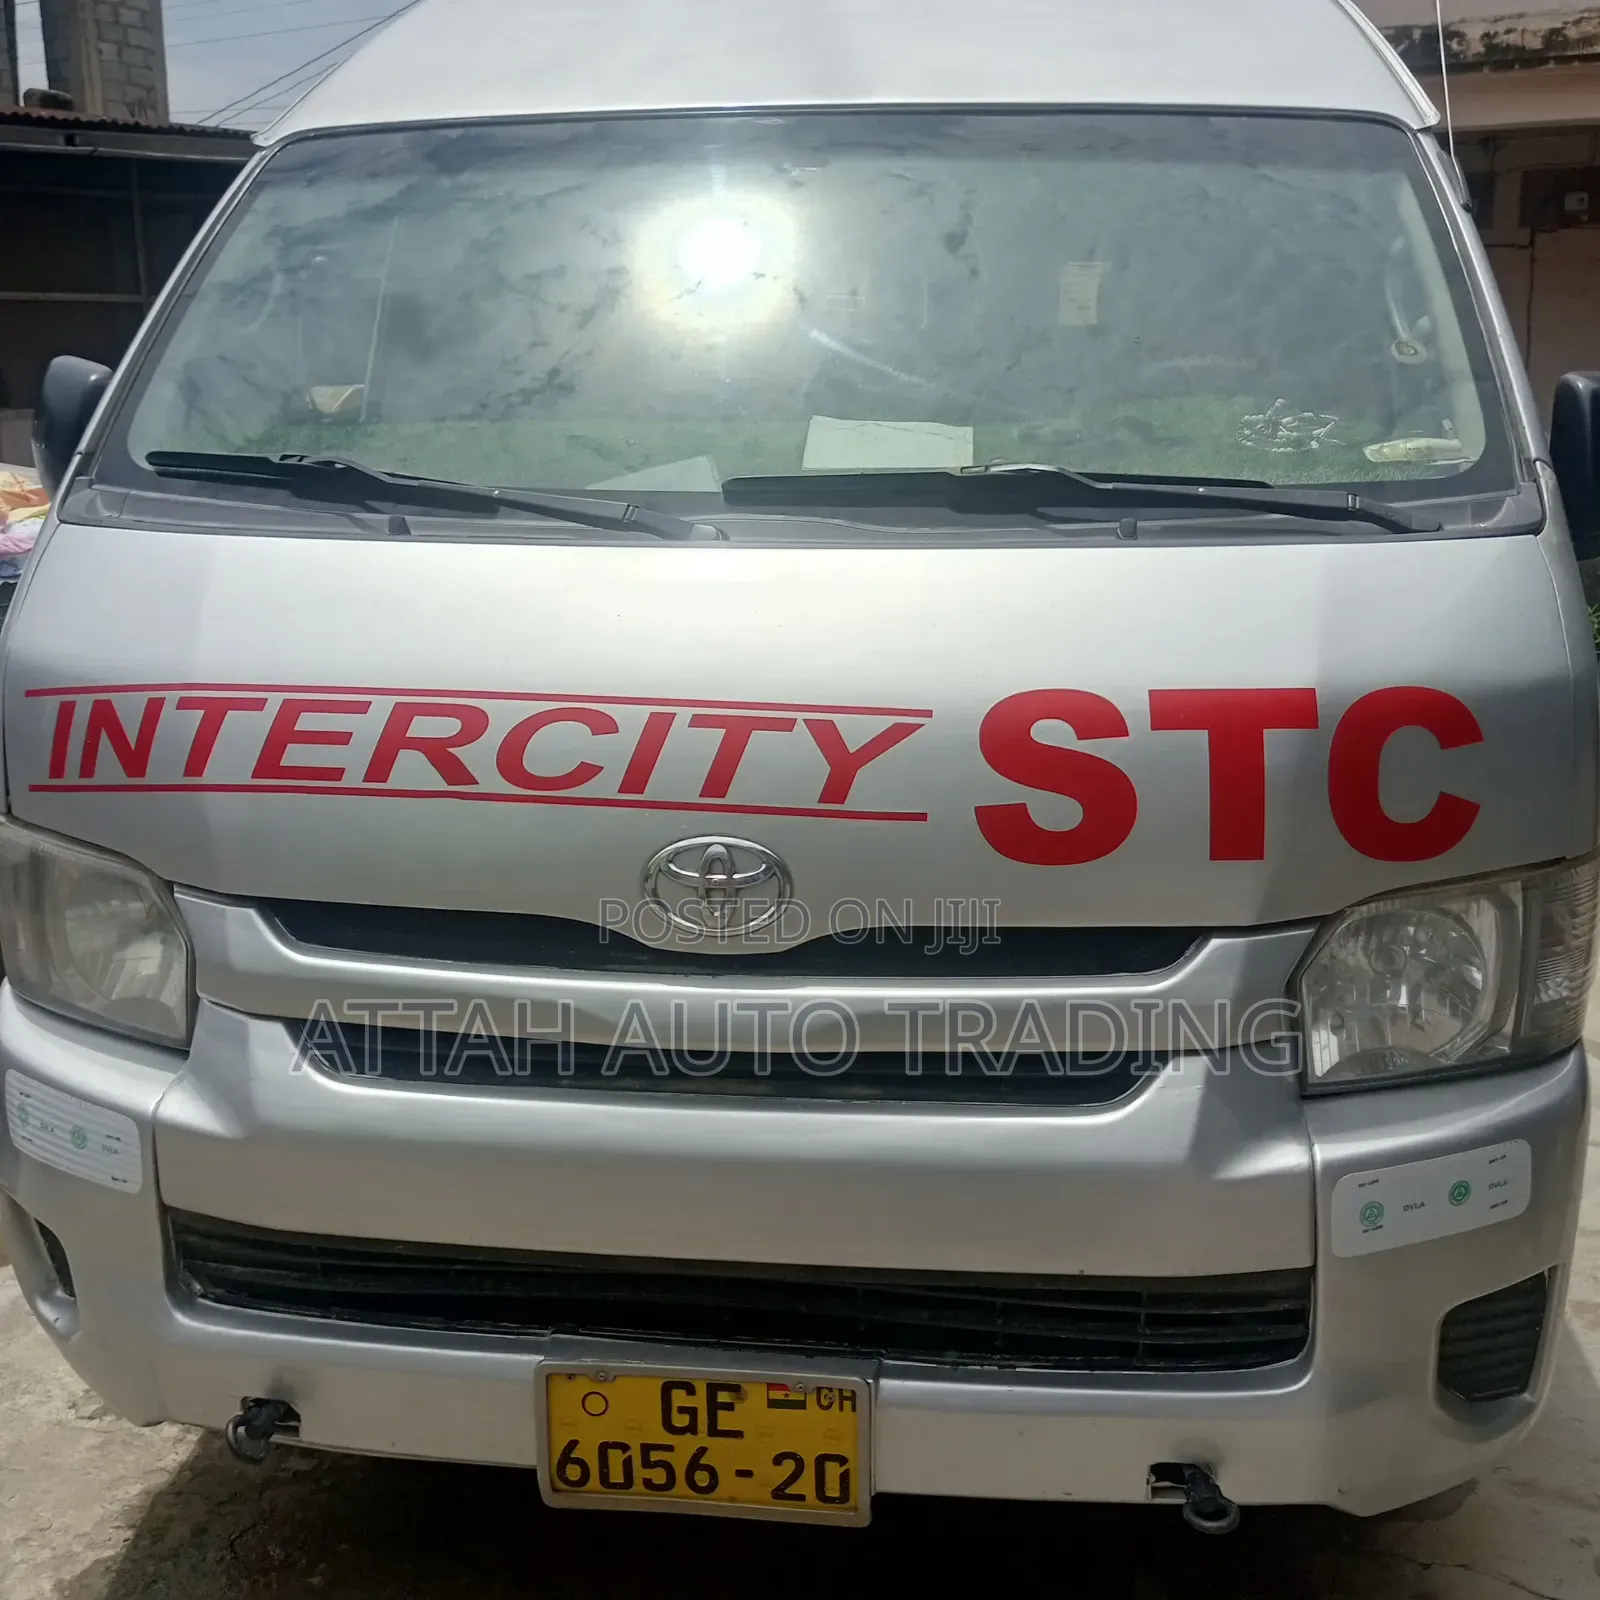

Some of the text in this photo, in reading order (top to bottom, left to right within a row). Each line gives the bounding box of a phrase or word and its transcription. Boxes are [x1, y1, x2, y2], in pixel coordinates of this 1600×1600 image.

[48, 686, 1485, 866] INTERCITY STC
[660, 1380, 744, 1440] GE
